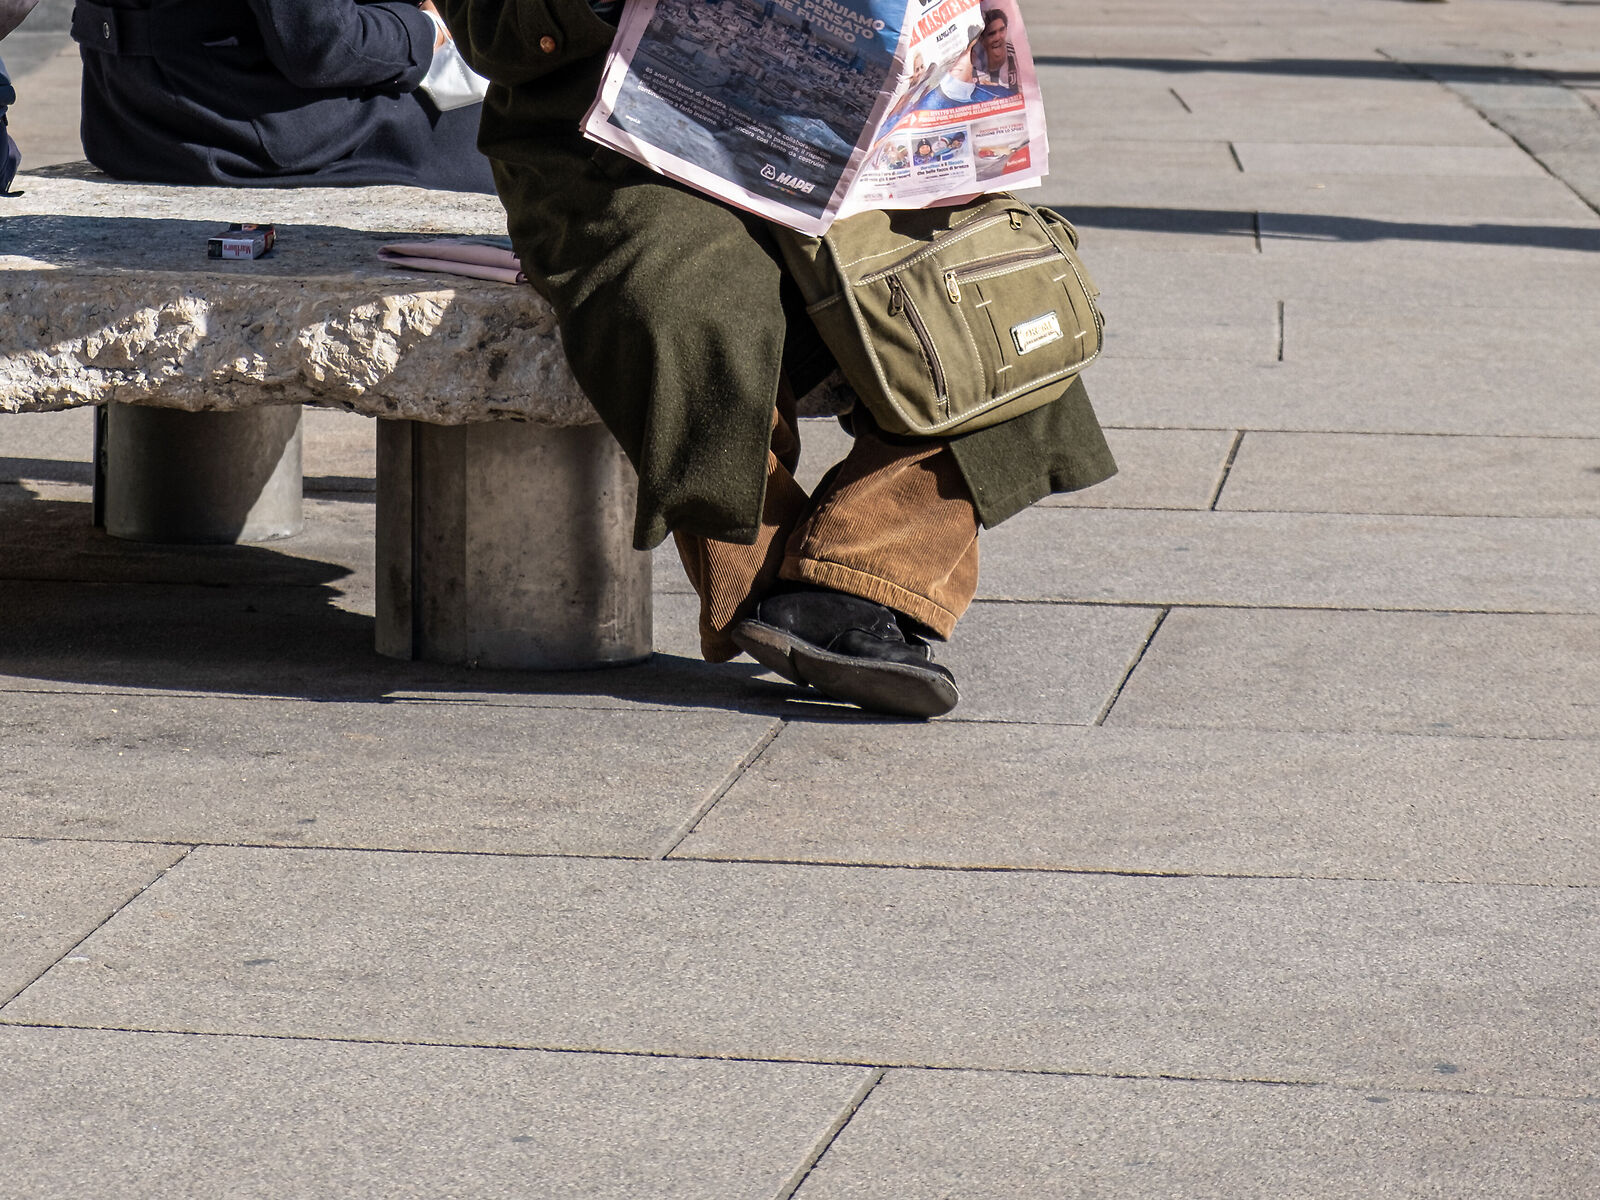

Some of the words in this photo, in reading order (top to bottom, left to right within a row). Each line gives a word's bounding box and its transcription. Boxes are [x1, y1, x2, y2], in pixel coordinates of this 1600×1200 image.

[796, 8, 857, 44] FUTURO
[805, 1, 875, 39] PENSATO
[776, 171, 816, 194] MAPEI
[223, 243, 252, 257] Marlboro
